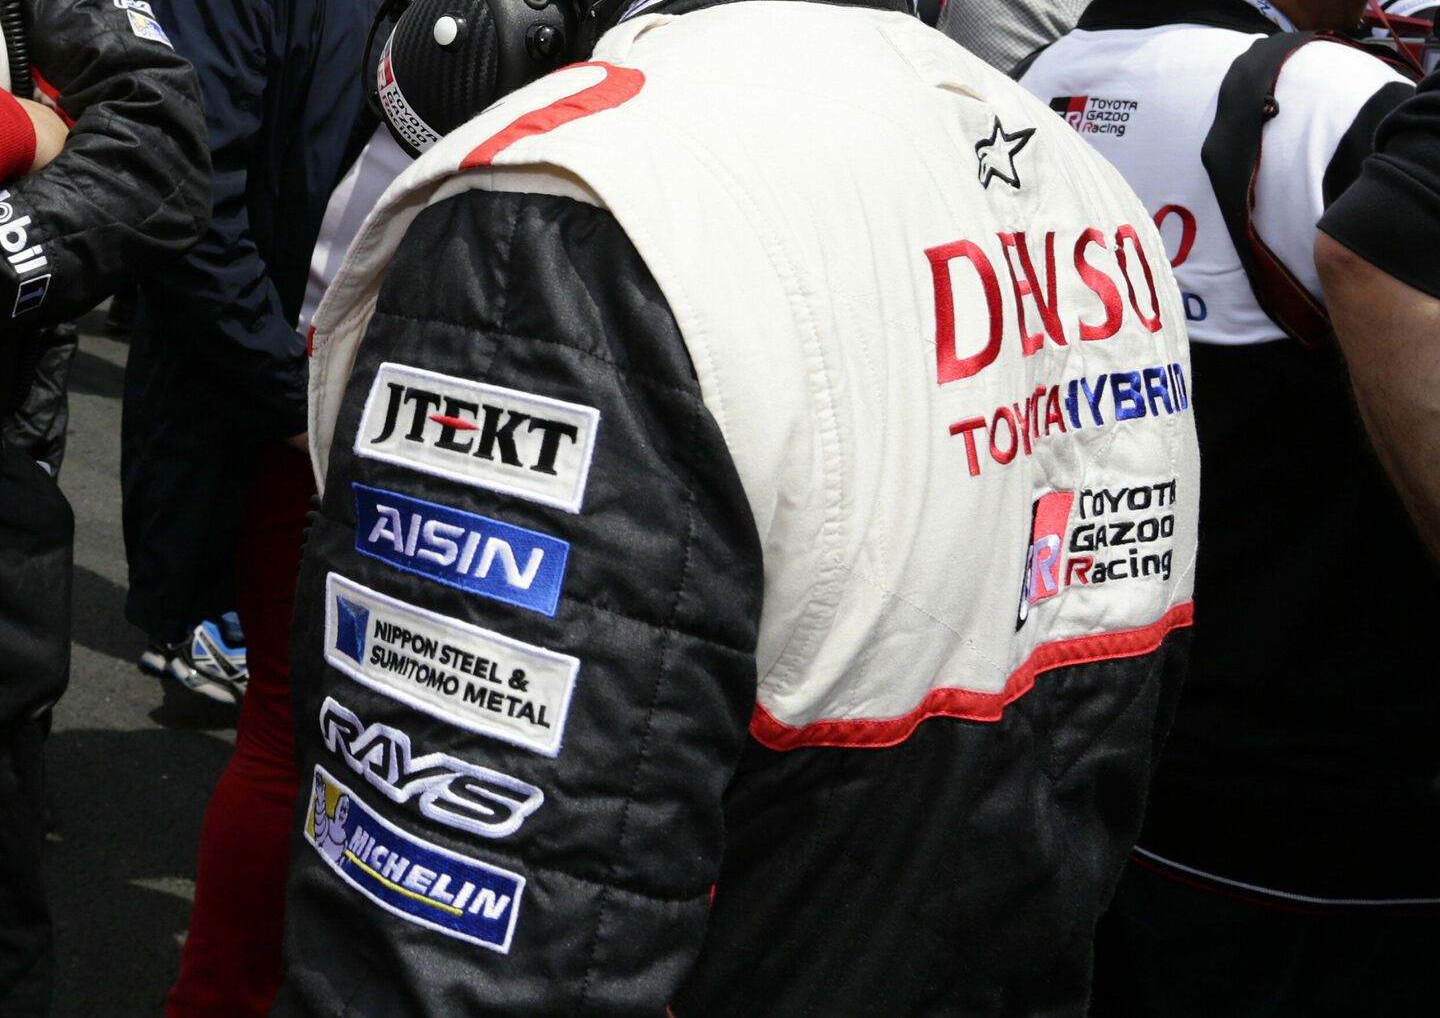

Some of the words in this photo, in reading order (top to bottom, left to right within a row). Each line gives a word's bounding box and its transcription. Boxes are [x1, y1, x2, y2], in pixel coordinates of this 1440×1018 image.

[386, 90, 428, 144] GAZOO
[392, 86, 439, 144] TOYOTA
[1081, 123, 1127, 138] Racing
[1085, 110, 1131, 122] GAZOO
[1089, 97, 1139, 111] TOYOTA
[923, 223, 1164, 385] DENSO
[371, 380, 579, 478] JTEKT
[948, 384, 1068, 477] TOYTA
[1064, 362, 1189, 429] HYBRID
[367, 503, 545, 591] AISIN
[1063, 547, 1174, 586] Racing
[1068, 513, 1175, 553] GAZOO
[370, 644, 459, 696] SUMITOMO
[462, 681, 551, 730] METAL
[373, 619, 439, 660] NIPPON
[439, 643, 503, 685] STEEL
[508, 668, 530, 693] &
[319, 695, 545, 839] RAYS
[348, 825, 511, 920] MICHELIN
